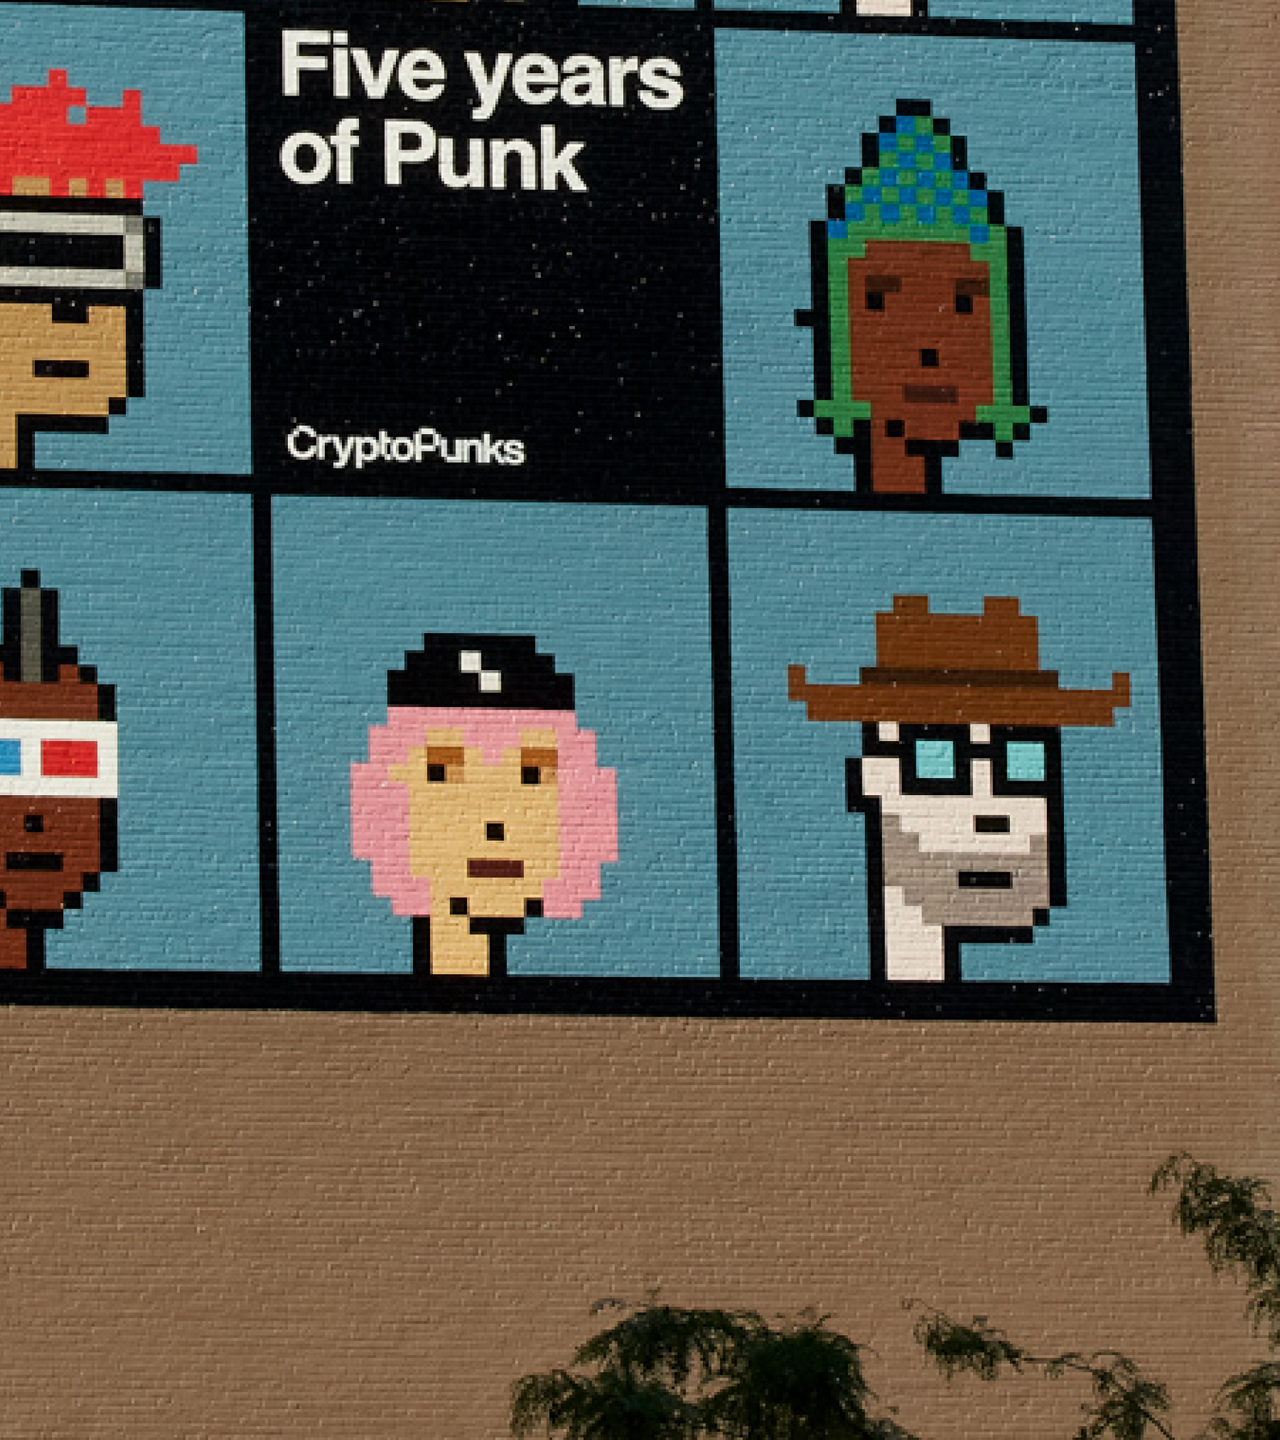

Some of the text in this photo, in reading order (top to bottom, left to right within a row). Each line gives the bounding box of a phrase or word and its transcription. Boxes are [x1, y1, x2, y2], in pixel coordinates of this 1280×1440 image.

[281, 29, 685, 121] Five years
[279, 118, 589, 192] of Punk
[286, 424, 526, 470] CryptoPunks
